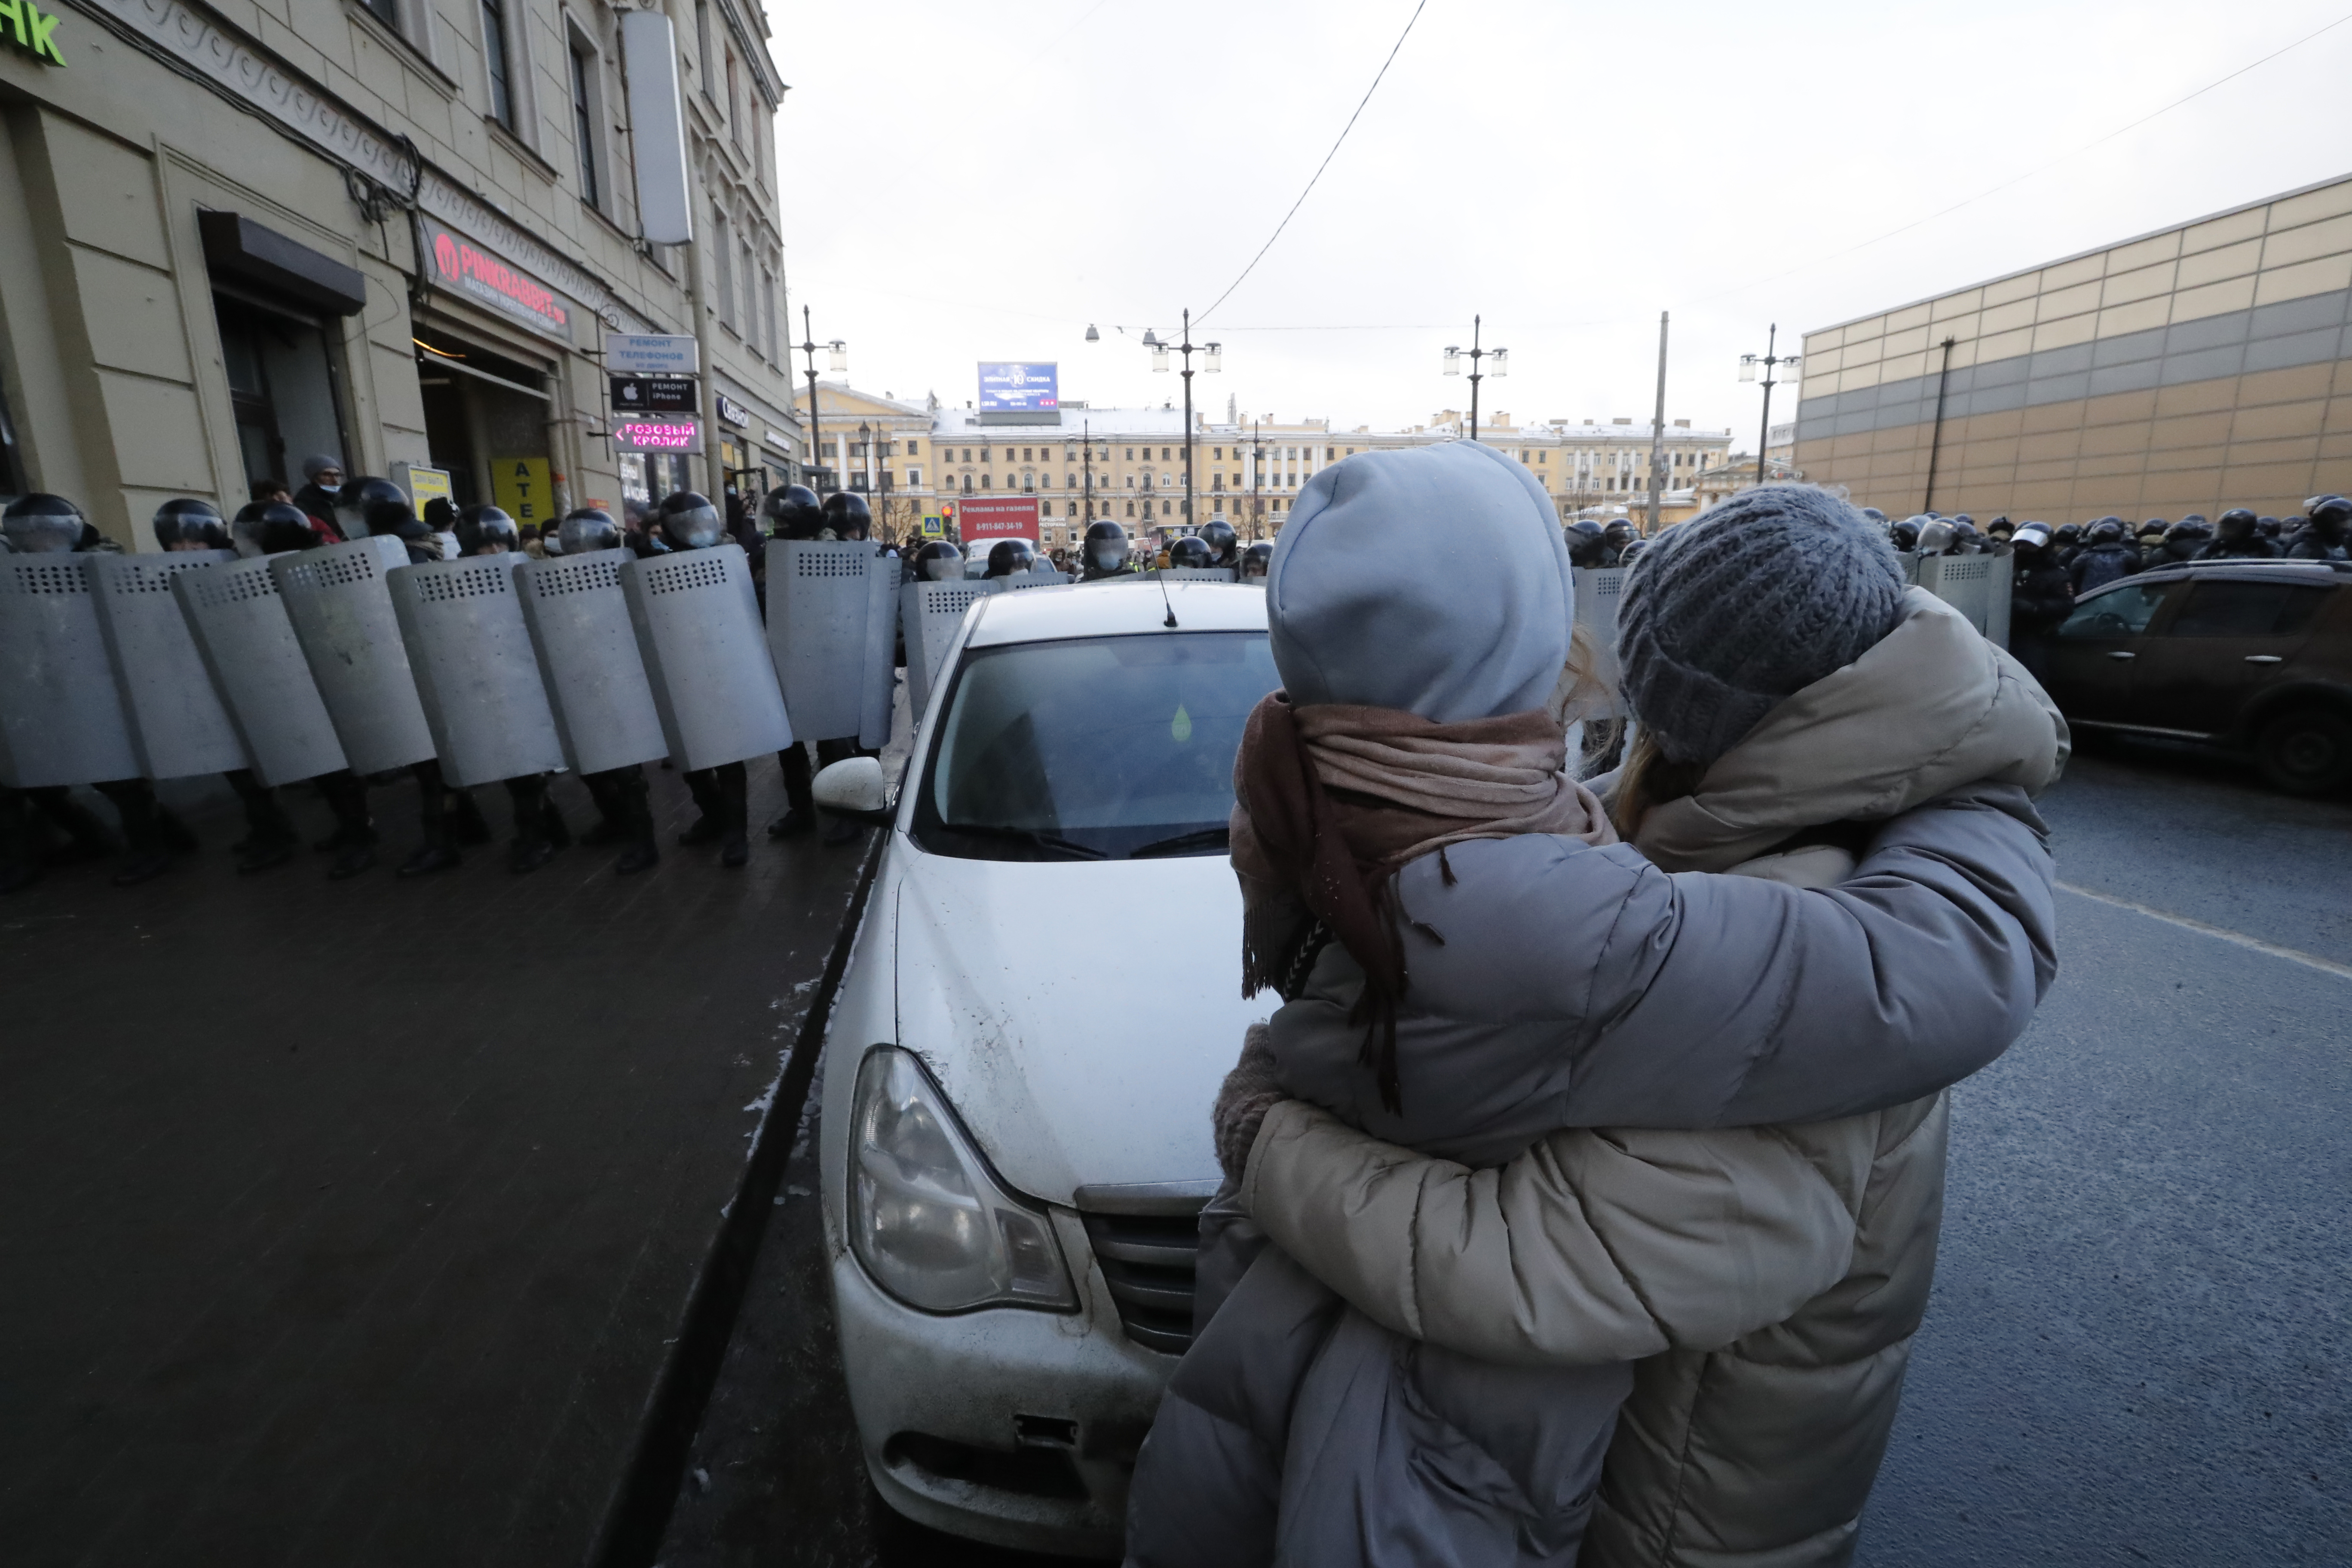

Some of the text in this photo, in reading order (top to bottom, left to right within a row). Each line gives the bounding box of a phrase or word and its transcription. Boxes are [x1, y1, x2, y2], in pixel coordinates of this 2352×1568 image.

[465, 276, 499, 300] МАГАЗИН
[629, 339, 671, 347] РЕМОНТ
[620, 351, 683, 360] ТЕЛЕФОНОВ
[625, 422, 696, 436] РОЗОВЫЙ
[633, 435, 689, 447] КРОЛИК
[631, 486, 650, 503] КОФЕ
[976, 522, 1023, 531] 8-911-847-34-19
